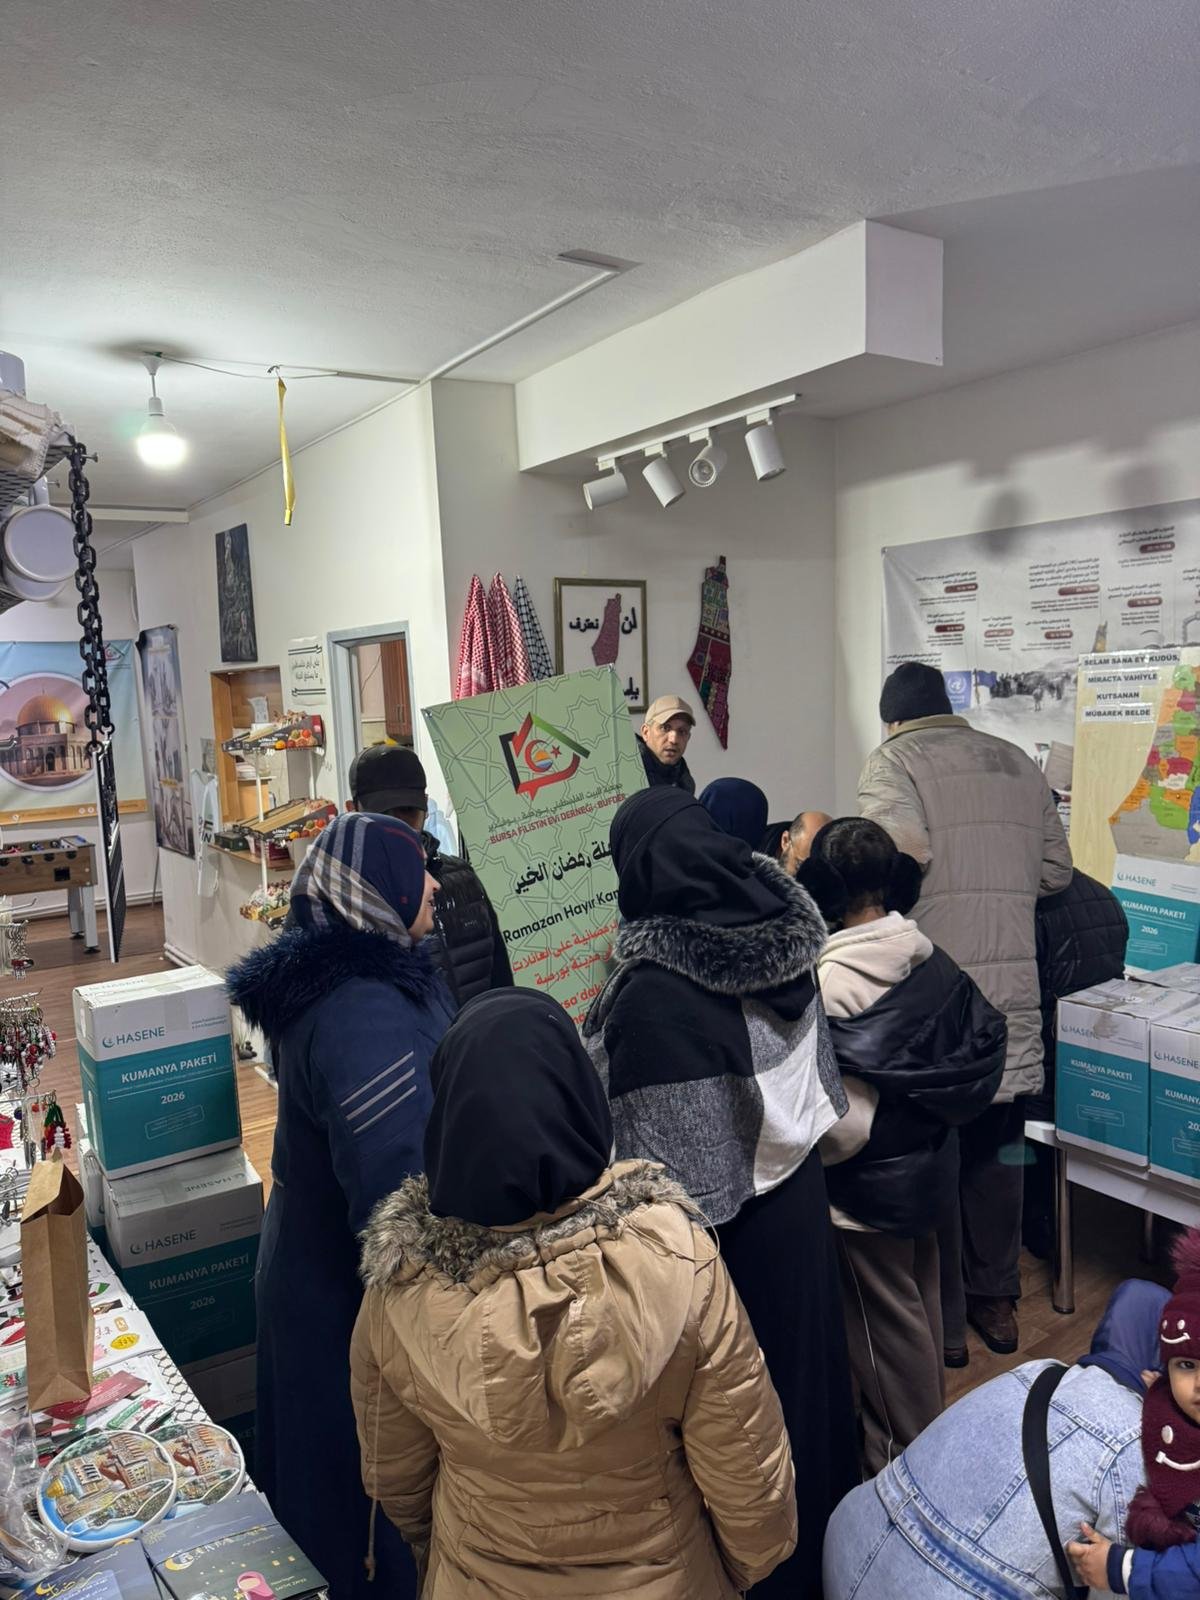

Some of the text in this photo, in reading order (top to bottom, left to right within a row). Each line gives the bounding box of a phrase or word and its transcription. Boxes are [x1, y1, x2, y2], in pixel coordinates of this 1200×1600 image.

[569, 607, 637, 634] لن نعترف
[1084, 658, 1111, 666] SELAM
[1111, 657, 1133, 665] SANA
[1134, 656, 1146, 664] EY
[1096, 692, 1140, 700] KUTSANAN
[1125, 708, 1151, 716] BELDE
[490, 830, 518, 844] BURSA
[552, 852, 592, 881] رمضان
[515, 862, 549, 895] الخير
[1125, 873, 1157, 887] HASENE
[1122, 901, 1186, 920] KUMANYA PAKETİ
[503, 912, 563, 943] Ramazan
[563, 899, 596, 919] Hayır
[1141, 925, 1159, 936] 2026
[116, 1026, 165, 1045] HASENE
[121, 1052, 217, 1084] KUMANYA PAKETİ
[1163, 1052, 1199, 1069] HASENE
[1070, 1059, 1132, 1081] KUMANYA PAKETİ
[161, 1091, 185, 1104] 2026
[1090, 1089, 1111, 1101] 2026
[1165, 1088, 1200, 1104] KUMANY
[1187, 1120, 1200, 1132] 20
[145, 1229, 198, 1251] HASENE
[149, 1253, 249, 1290] KUMANYA PAKETİ
[190, 1295, 216, 1310] 2026
